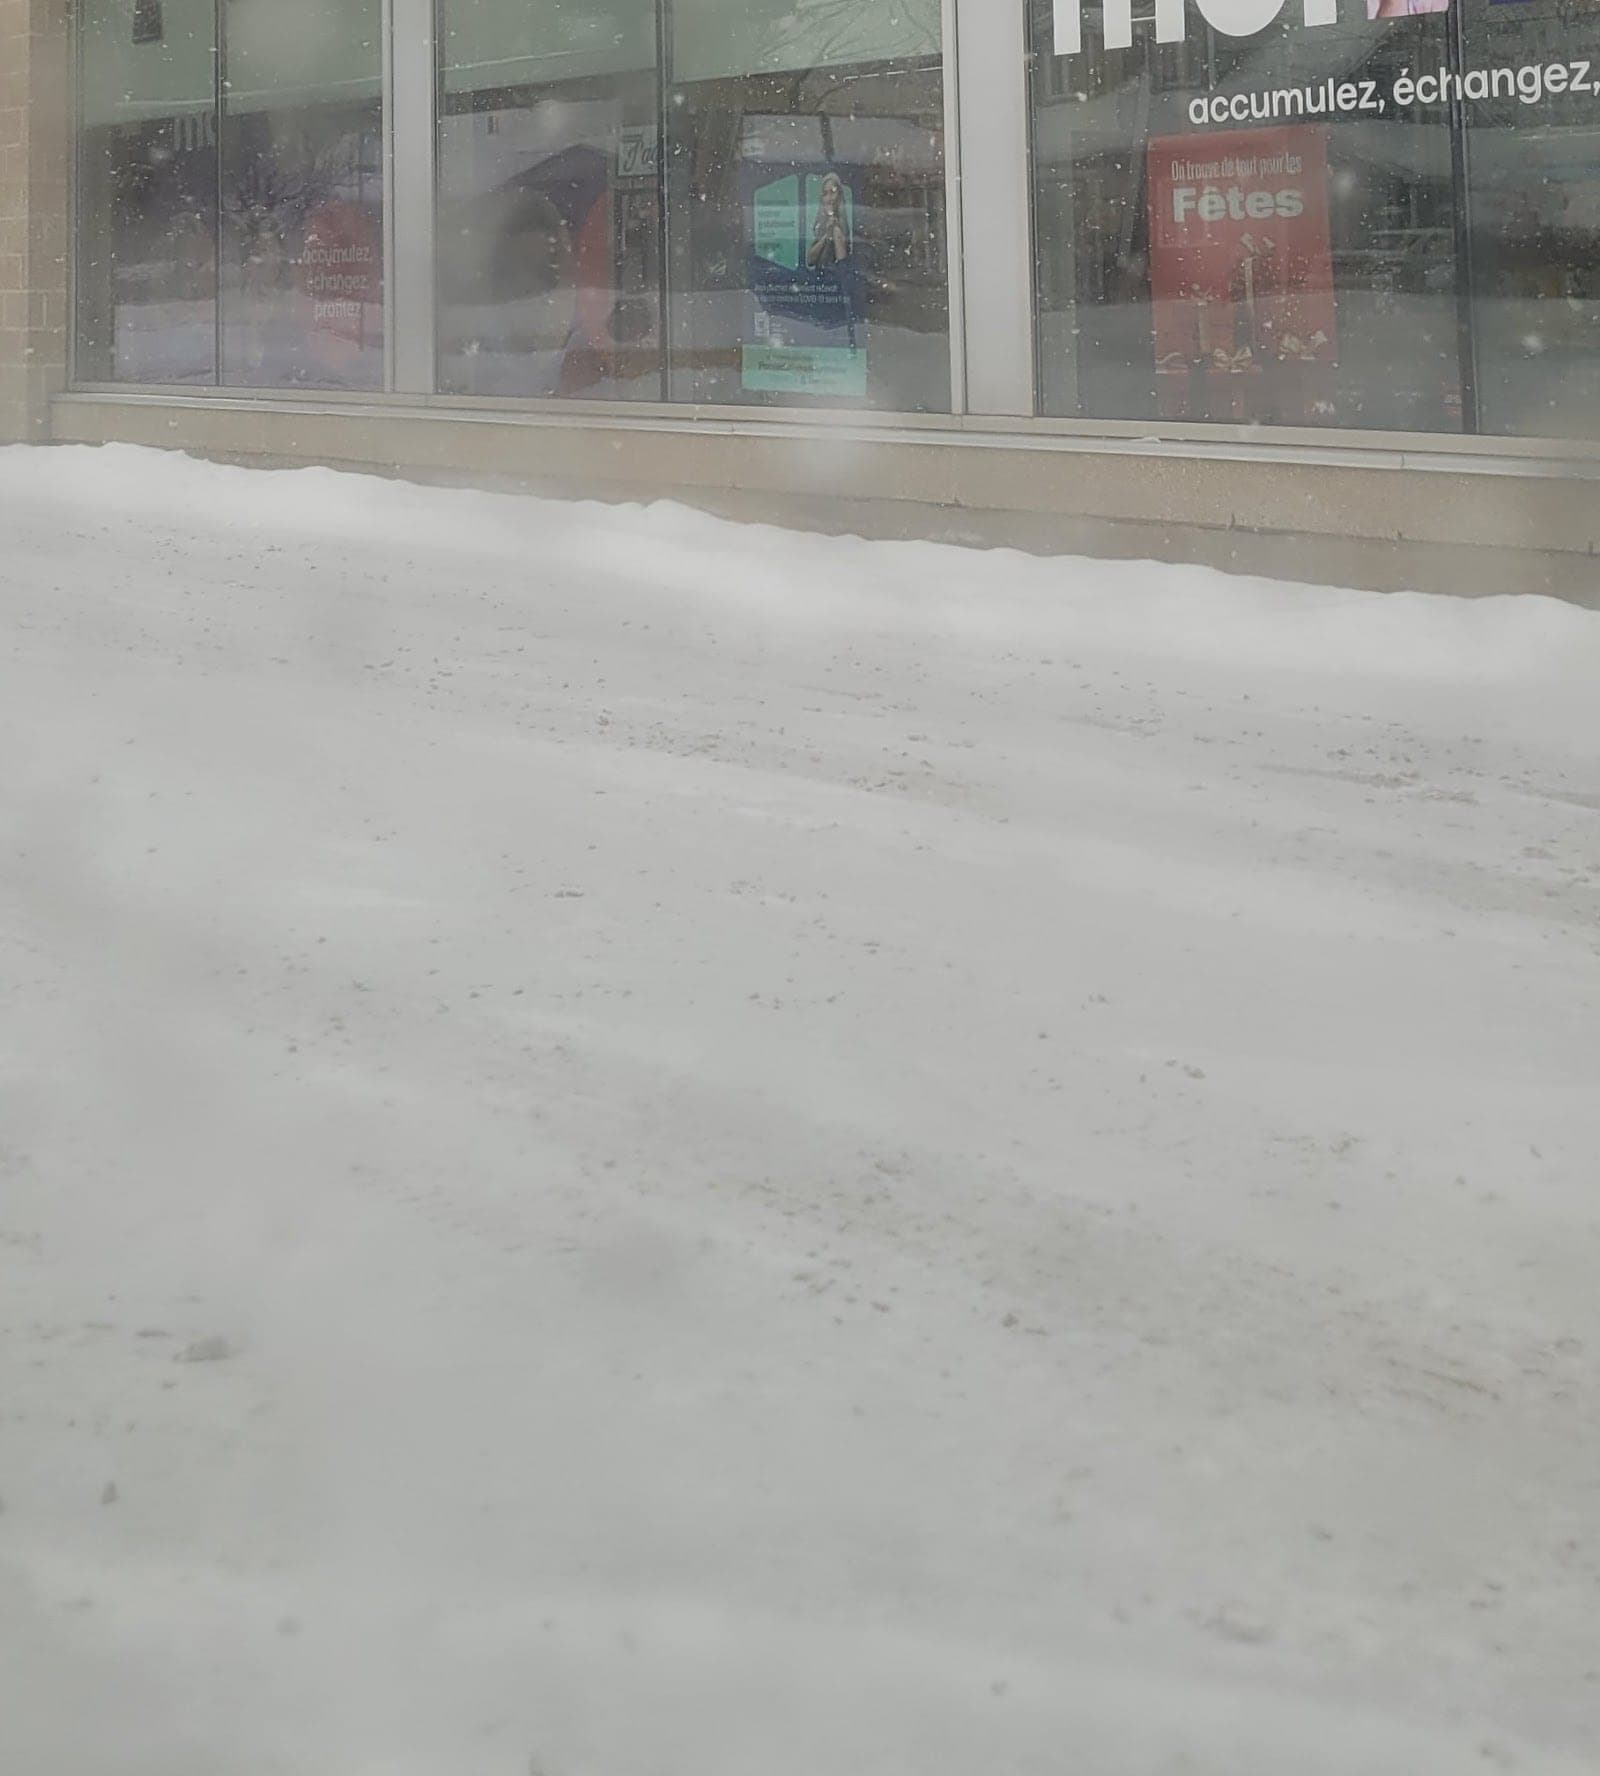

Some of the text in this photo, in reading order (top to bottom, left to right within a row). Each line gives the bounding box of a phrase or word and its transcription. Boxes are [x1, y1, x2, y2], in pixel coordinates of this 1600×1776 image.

[1188, 60, 1600, 124] accumulez, échangez,
[1171, 159, 1184, 181] On
[1173, 186, 1304, 223] Fêtes
